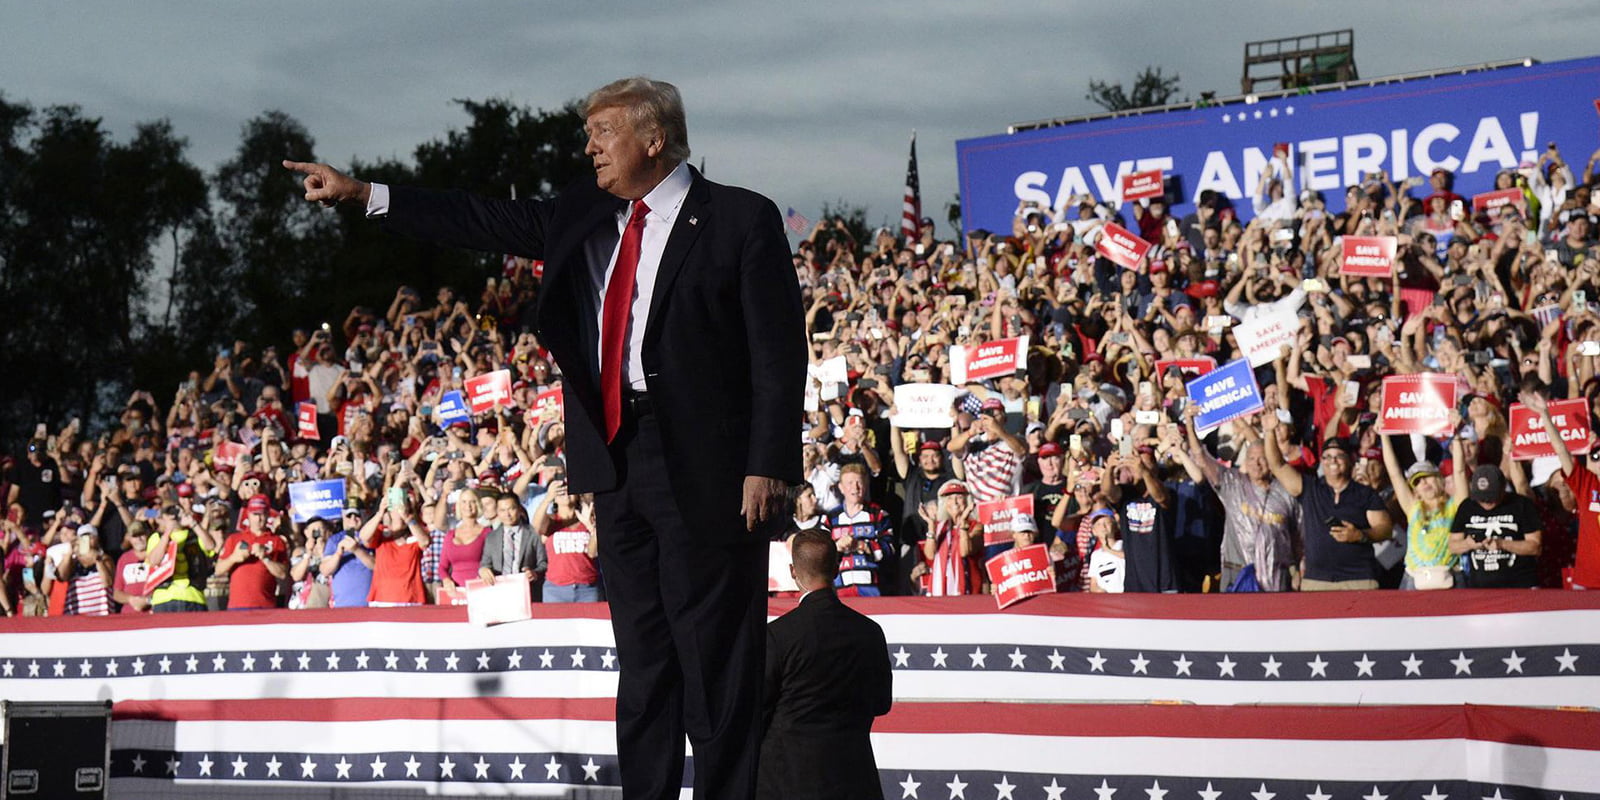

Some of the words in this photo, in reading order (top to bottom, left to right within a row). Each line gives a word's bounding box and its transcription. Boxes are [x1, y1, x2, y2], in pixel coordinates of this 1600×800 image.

[1193, 112, 1539, 203] AMERICA!
[1112, 233, 1136, 250] SAVE
[1102, 239, 1140, 261] ERICA!
[1355, 245, 1380, 255] SAVE
[1345, 256, 1390, 267] AMERICA!
[1256, 322, 1282, 338] SAVE
[1249, 330, 1299, 354] AMERICA
[978, 345, 1004, 358] SAVE
[968, 353, 1014, 371] AMERICA!
[476, 383, 496, 394] SAV
[1204, 376, 1236, 398] SAVE
[1399, 391, 1432, 404] SAV
[1515, 427, 1587, 446] AMECA!
[305, 489, 332, 501] SAVE
[298, 498, 343, 511] ERICA!
[992, 508, 1019, 521] SAVE
[1001, 558, 1033, 577] SAVE
[998, 569, 1049, 595] AMERICA!
